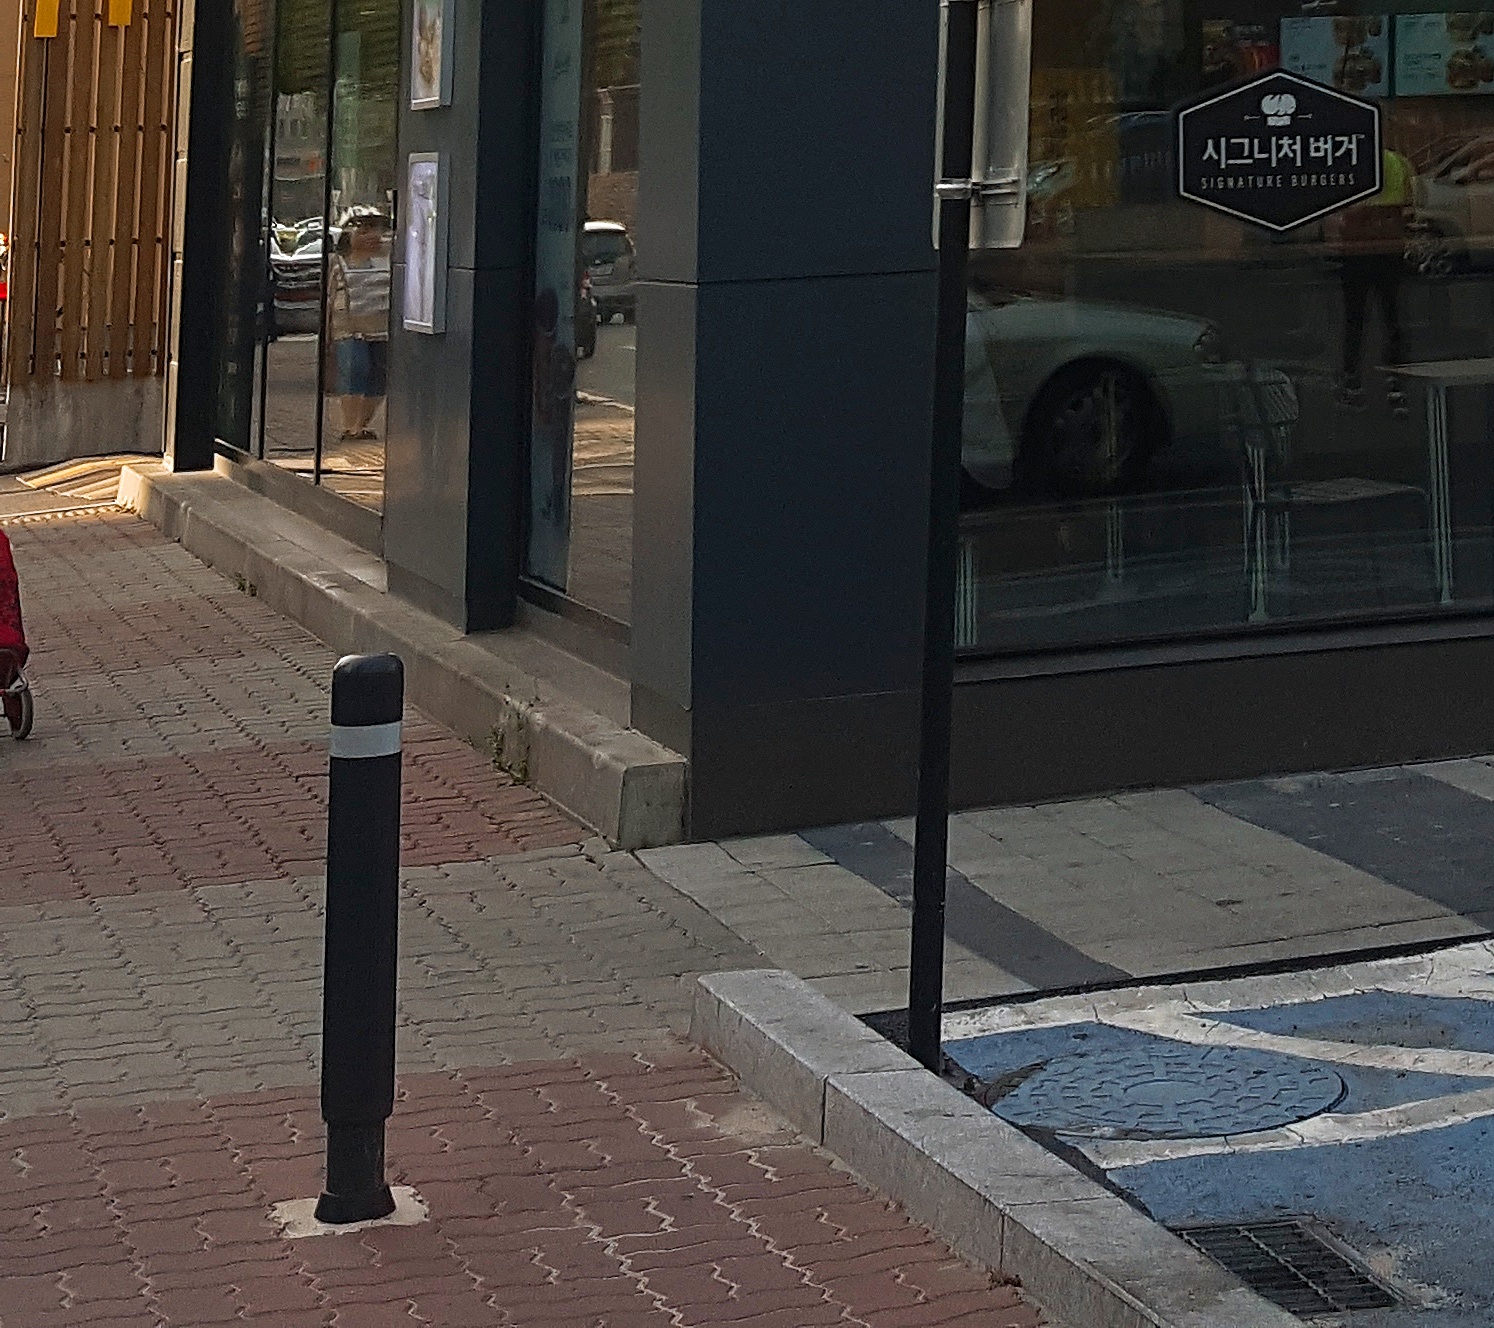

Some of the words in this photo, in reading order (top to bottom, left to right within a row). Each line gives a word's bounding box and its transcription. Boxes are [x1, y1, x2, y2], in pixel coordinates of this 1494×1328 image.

[1202, 136, 1301, 169] 시그니처
[1310, 134, 1358, 166] 버거
[1201, 175, 1283, 190] SIGNATURE
[1292, 173, 1355, 187] BURGERS
